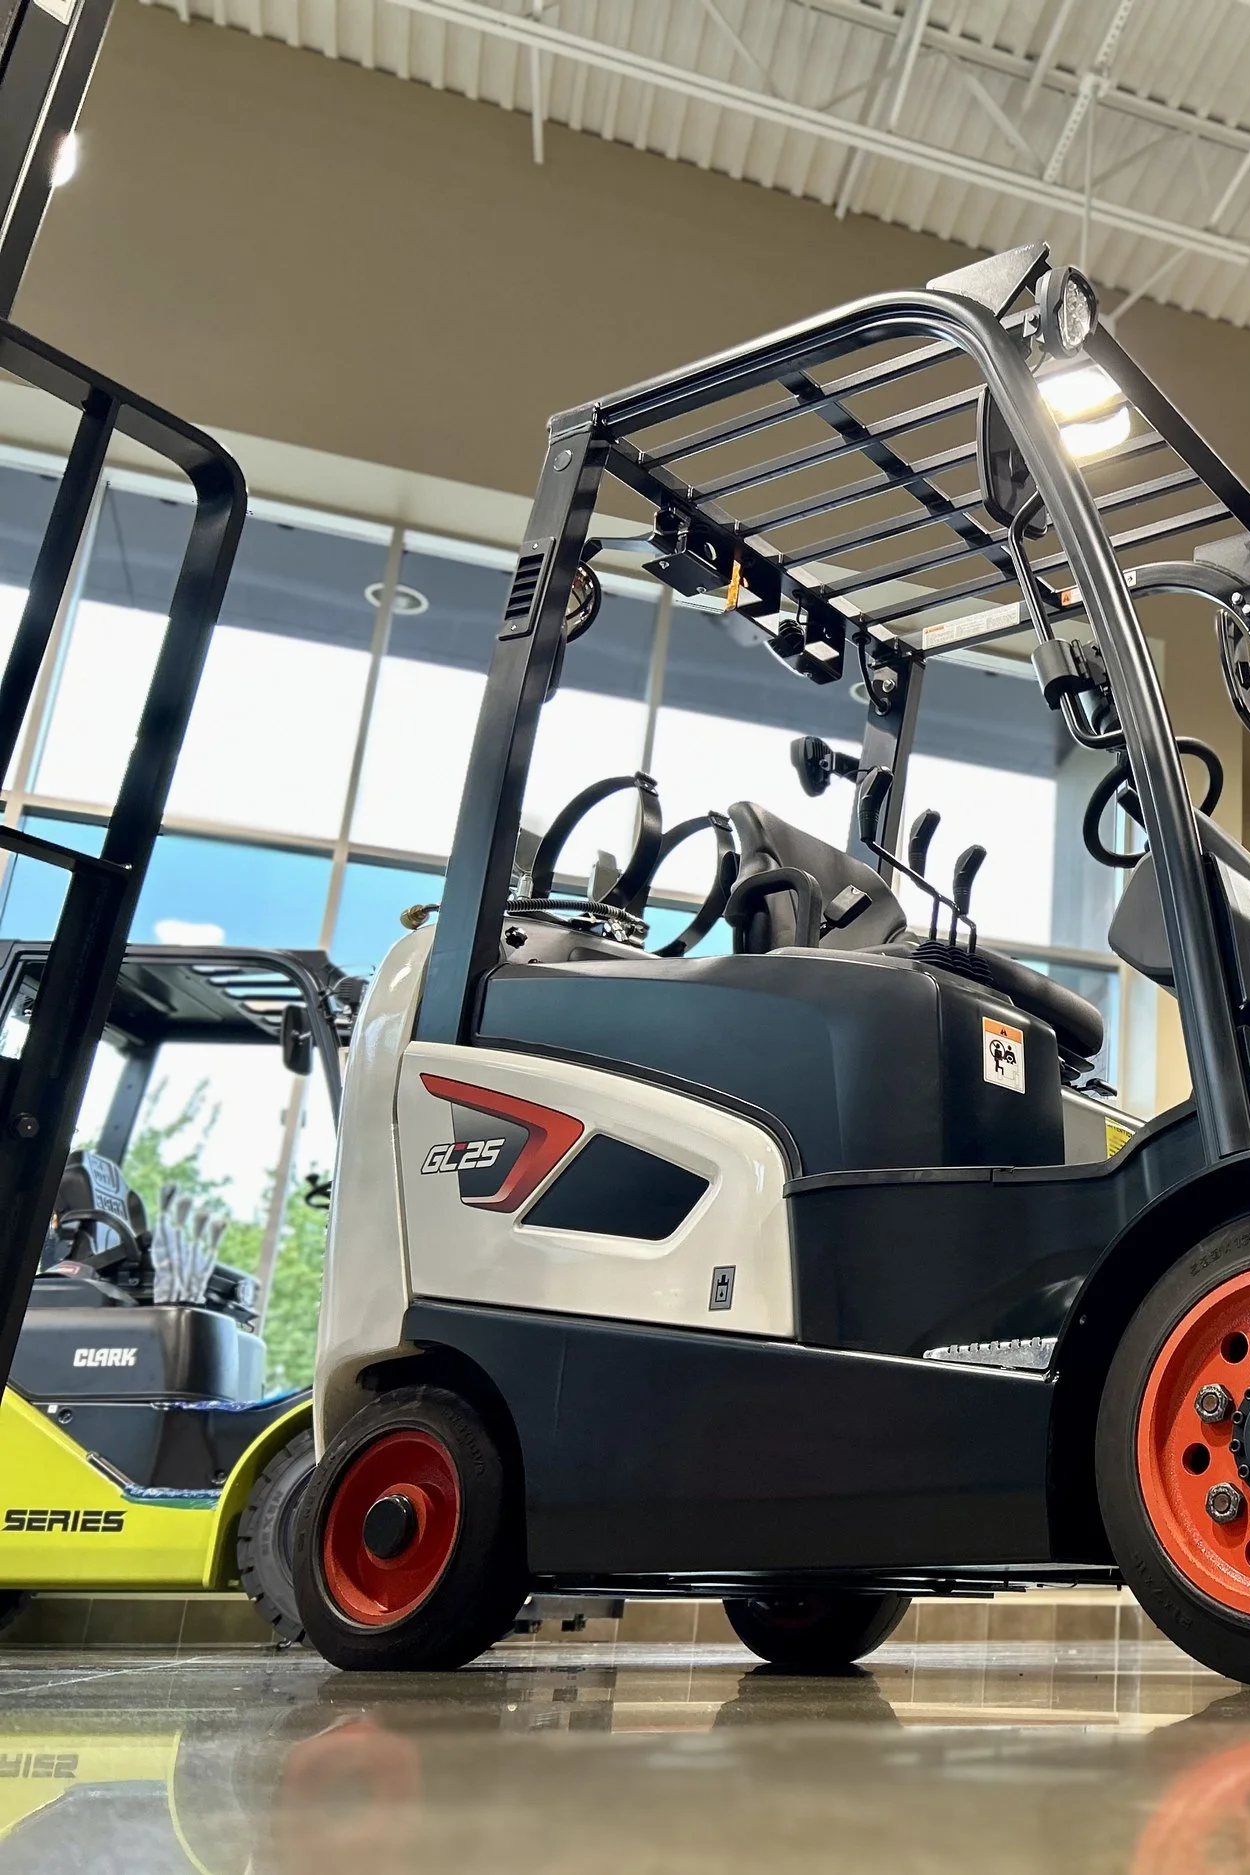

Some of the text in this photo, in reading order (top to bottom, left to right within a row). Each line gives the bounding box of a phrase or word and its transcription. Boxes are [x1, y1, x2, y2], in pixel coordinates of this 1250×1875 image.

[421, 1137, 506, 1174] GC25
[73, 1348, 138, 1367] CLARK
[1, 1509, 128, 1532] SERIES
